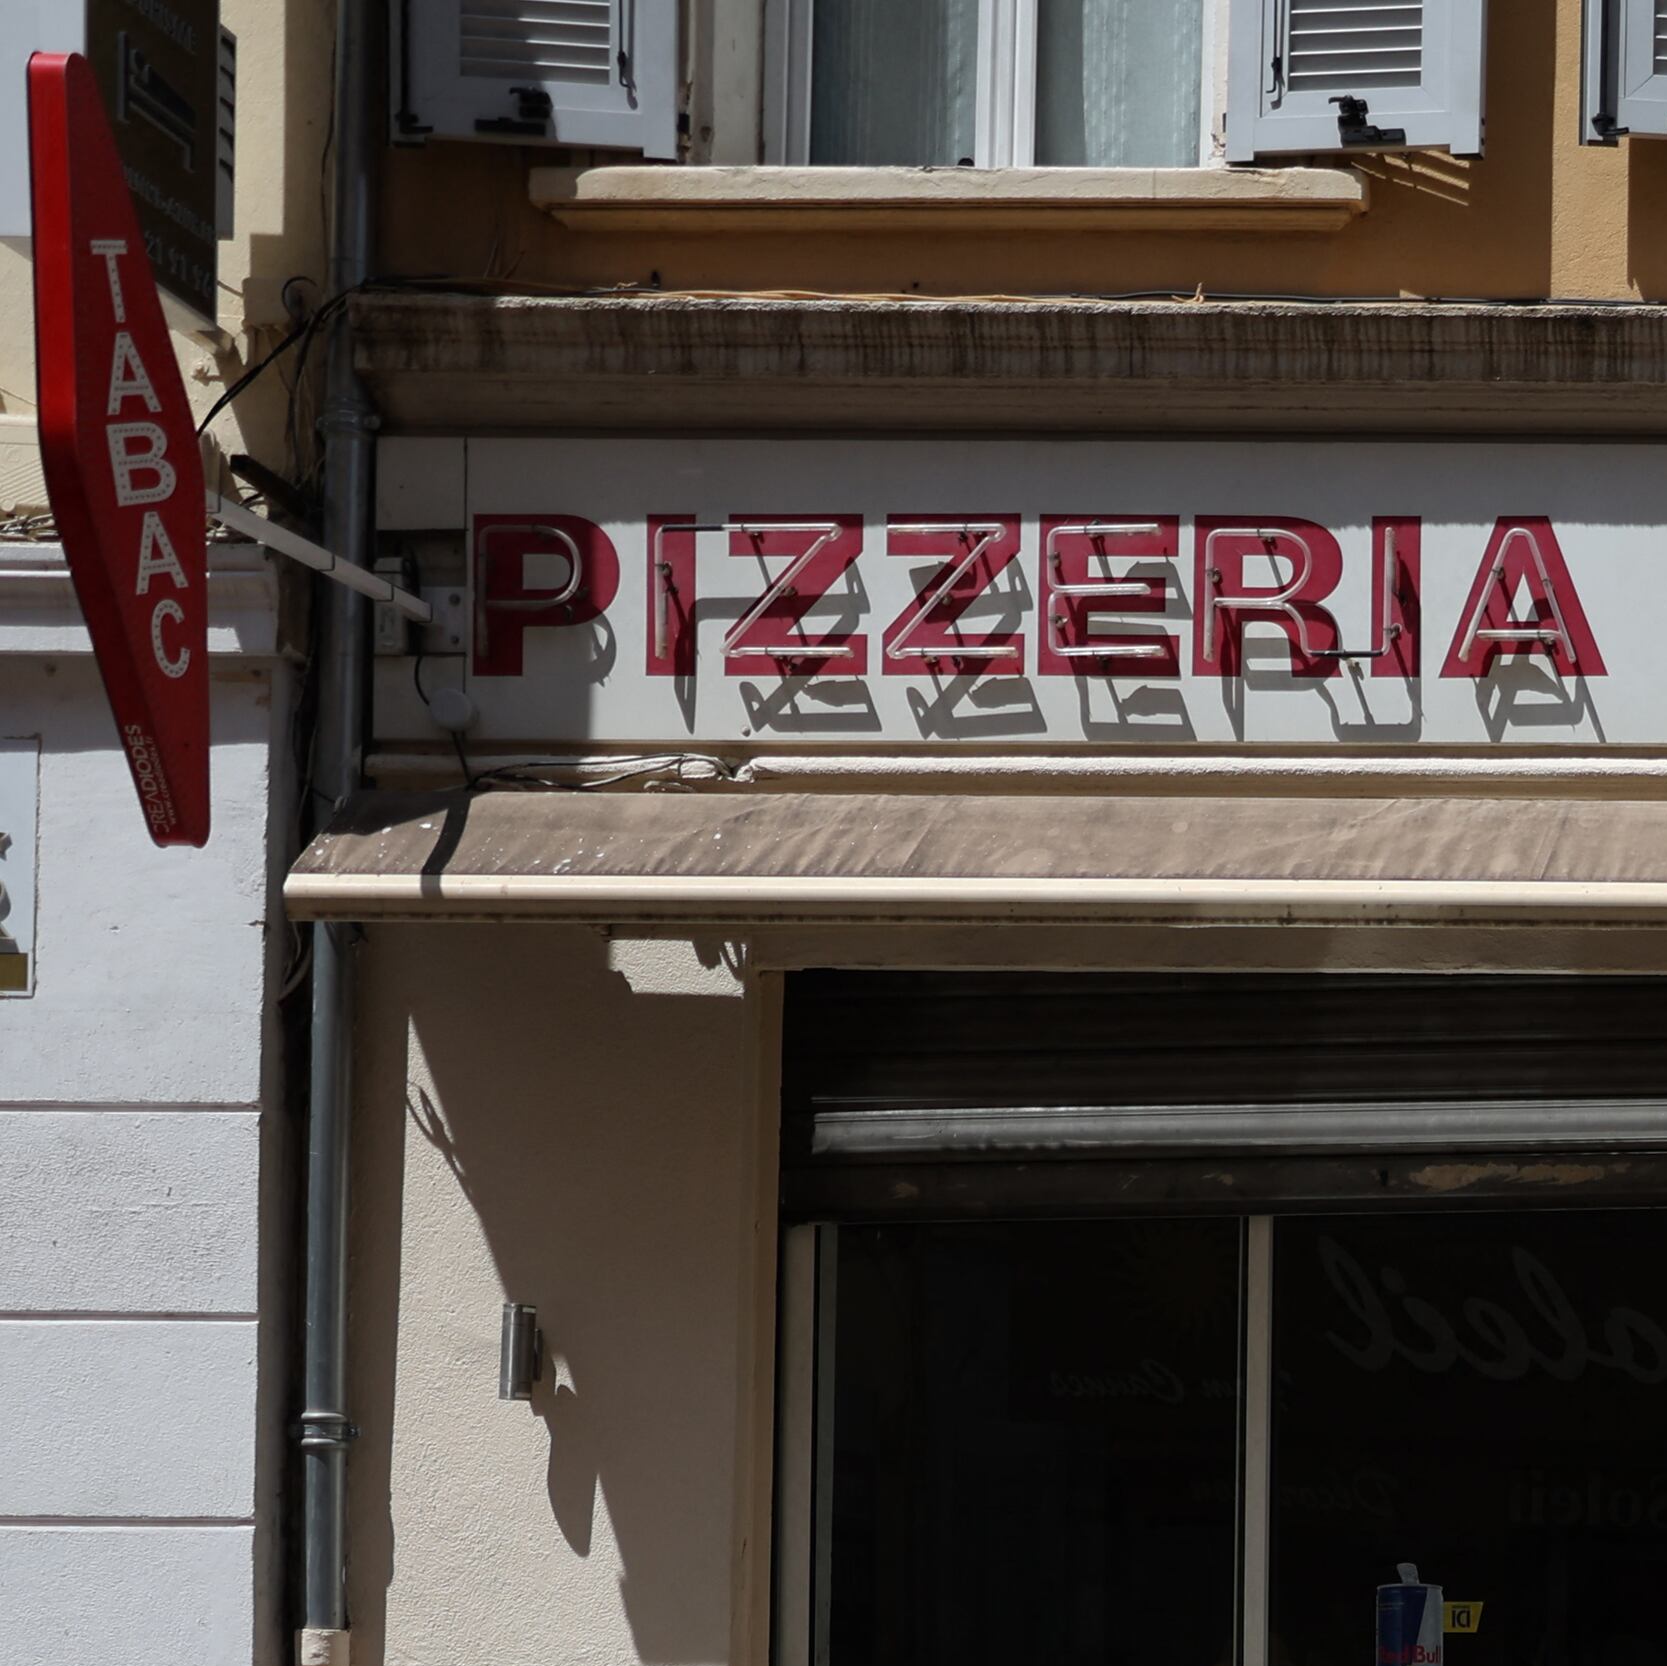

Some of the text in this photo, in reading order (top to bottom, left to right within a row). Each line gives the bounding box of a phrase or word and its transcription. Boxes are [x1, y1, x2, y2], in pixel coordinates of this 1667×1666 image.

[90, 239, 191, 679] TABAC
[472, 513, 1608, 679] PIZZERIA
[1413, 1644, 1442, 1665] Bull
